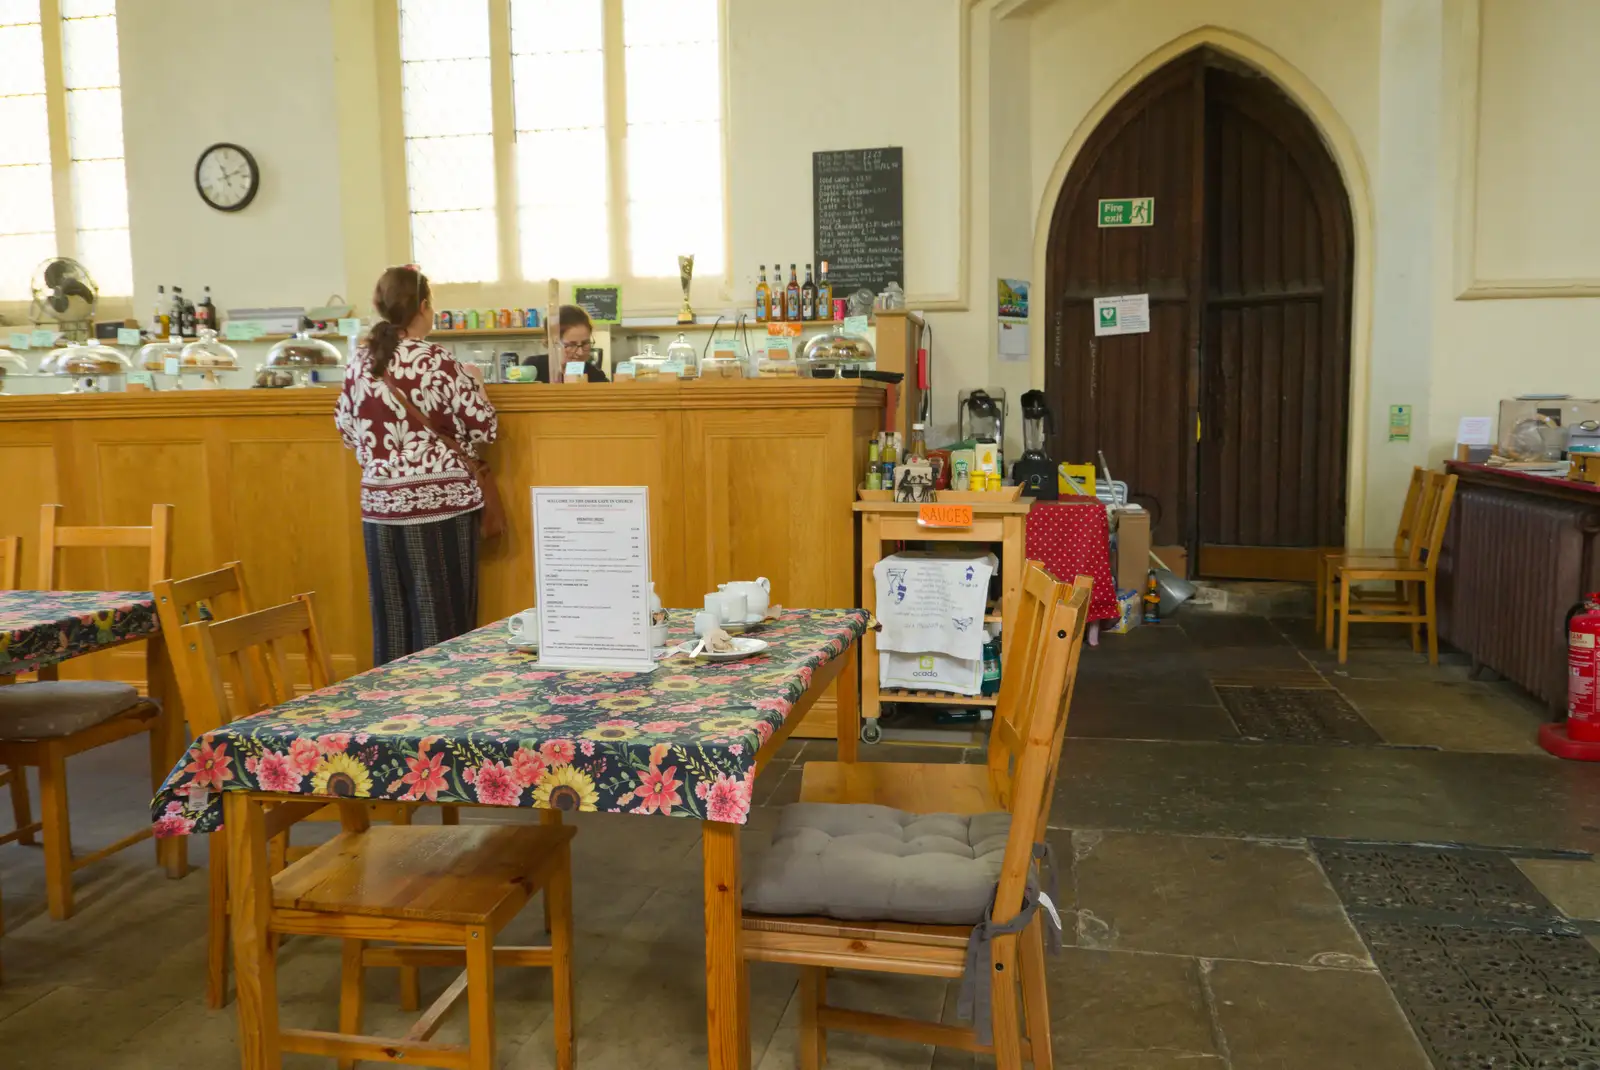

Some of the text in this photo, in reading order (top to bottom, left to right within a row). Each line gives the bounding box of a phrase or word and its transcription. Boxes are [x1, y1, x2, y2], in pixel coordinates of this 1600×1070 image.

[1104, 203, 1123, 213] Fire
[1104, 213, 1123, 223] exit
[921, 506, 971, 525] SAUCES
[912, 669, 938, 678] ocado
